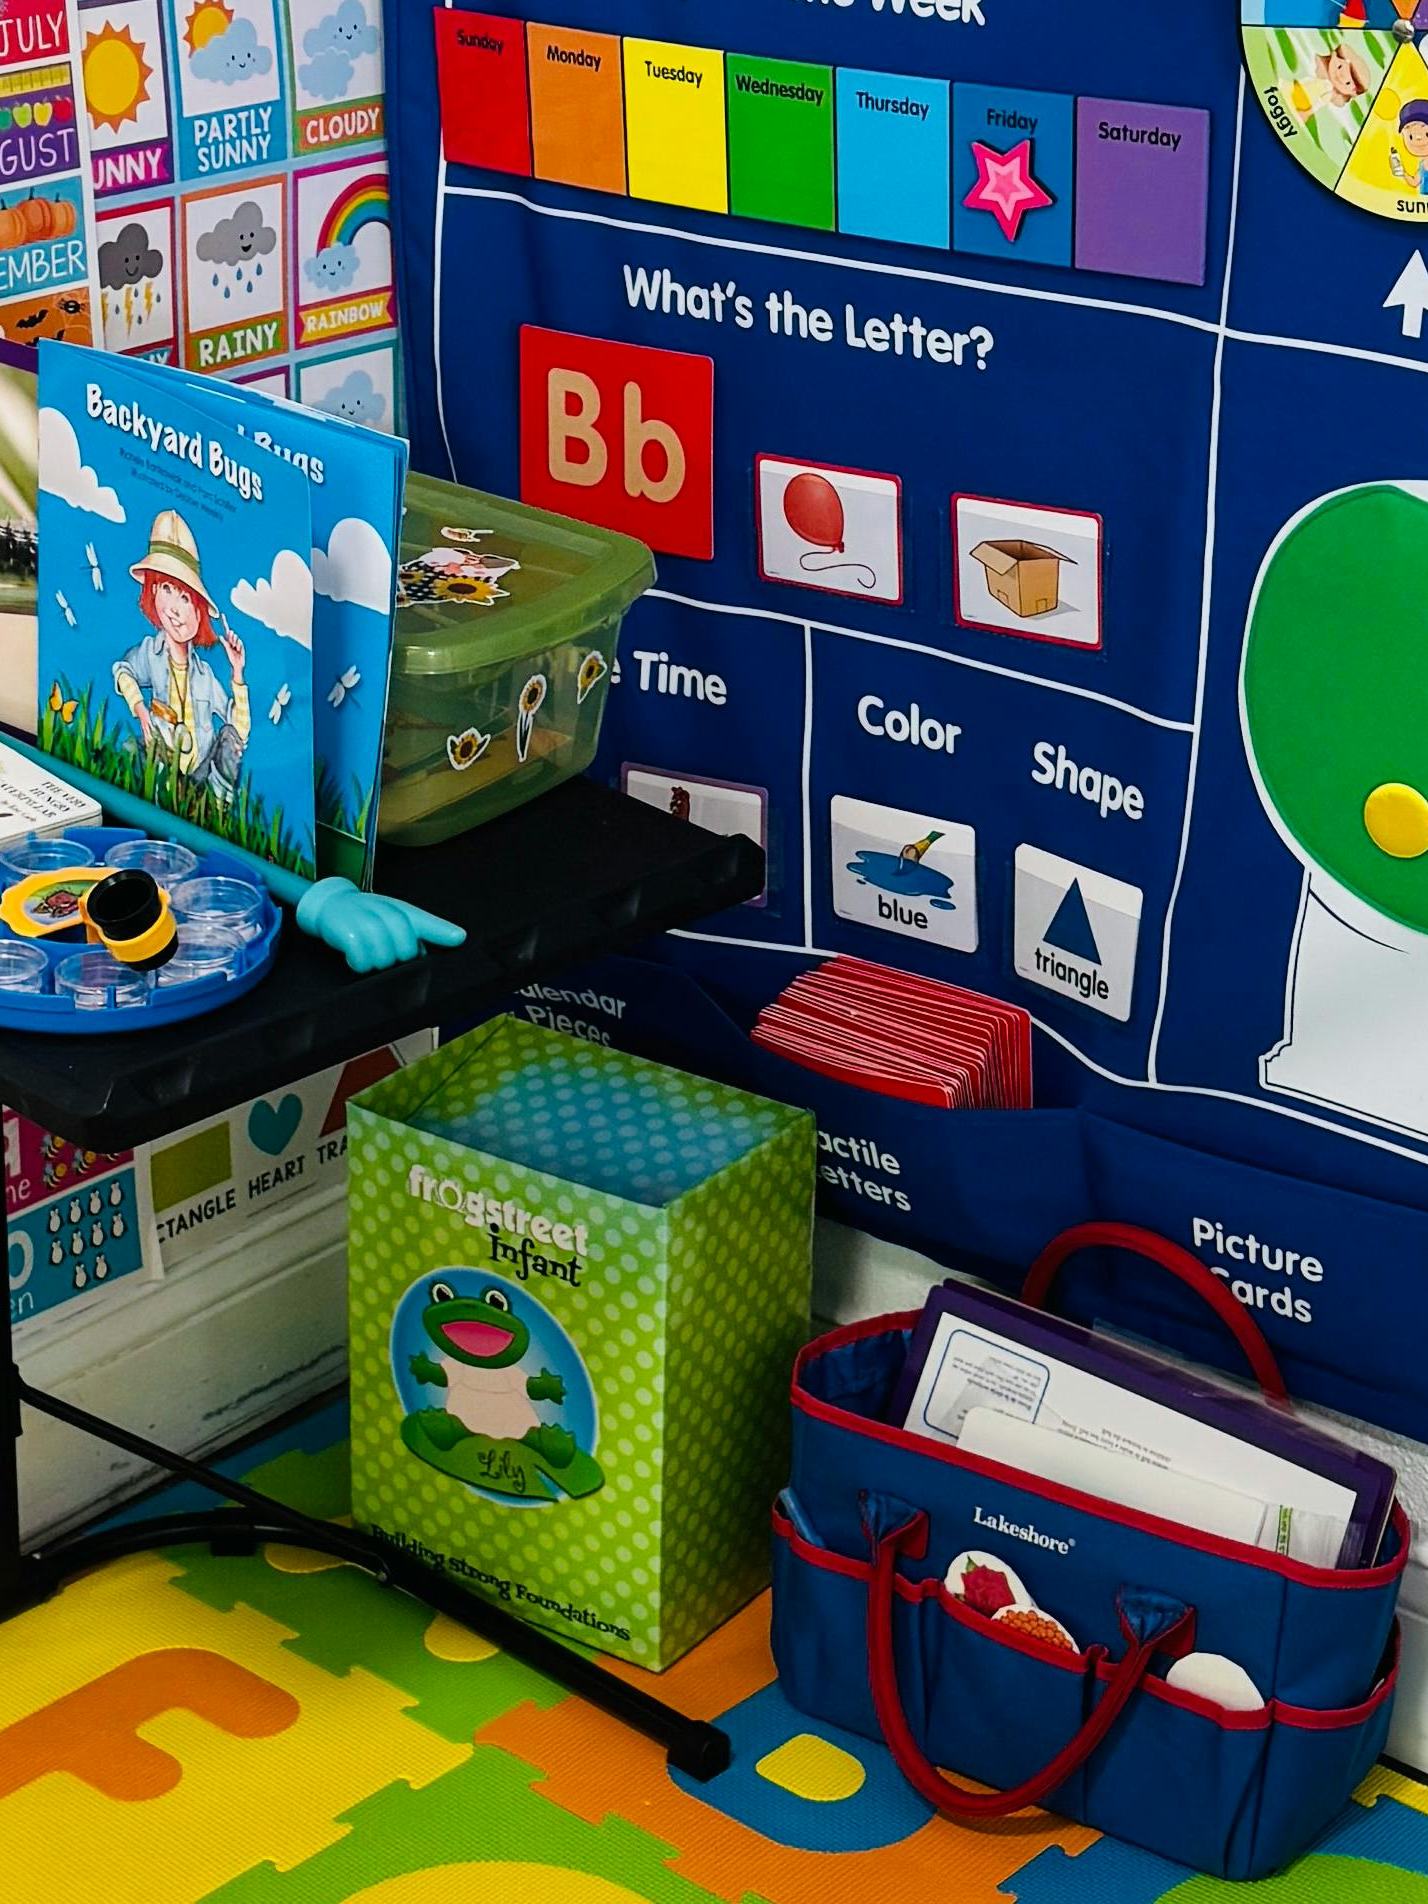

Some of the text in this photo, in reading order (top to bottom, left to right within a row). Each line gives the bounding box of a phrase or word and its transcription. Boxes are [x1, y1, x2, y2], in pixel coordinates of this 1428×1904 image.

[456, 27, 504, 55] Sunday
[546, 43, 602, 74] Monday
[644, 59, 704, 91] Tuesday
[735, 72, 825, 108] Wednesday
[193, 106, 274, 147] PARTLY
[305, 106, 381, 146] CLOUDY
[855, 90, 930, 122] Thursday
[985, 108, 1039, 137] Friday
[1262, 84, 1300, 140] foggy
[197, 133, 272, 174] SUNNY
[1098, 120, 1183, 152] Saturday
[305, 299, 387, 335] RAINBOW
[622, 264, 995, 371] What's the Letter?
[198, 321, 279, 368] RAINY
[86, 383, 204, 470] Backyard
[208, 441, 264, 501] Bugs
[547, 367, 687, 504] Bb
[633, 650, 728, 706] Time
[857, 695, 963, 755] Color
[1033, 742, 1145, 822] Shape
[878, 893, 929, 932] blue
[1033, 947, 1110, 1002] triangle
[247, 1155, 306, 1200] HEART
[407, 1163, 590, 1258] frogstreet
[1192, 1216, 1325, 1284] Picture
[477, 1448, 529, 1495] Lily
[514, 1582, 631, 1643] Foundations
